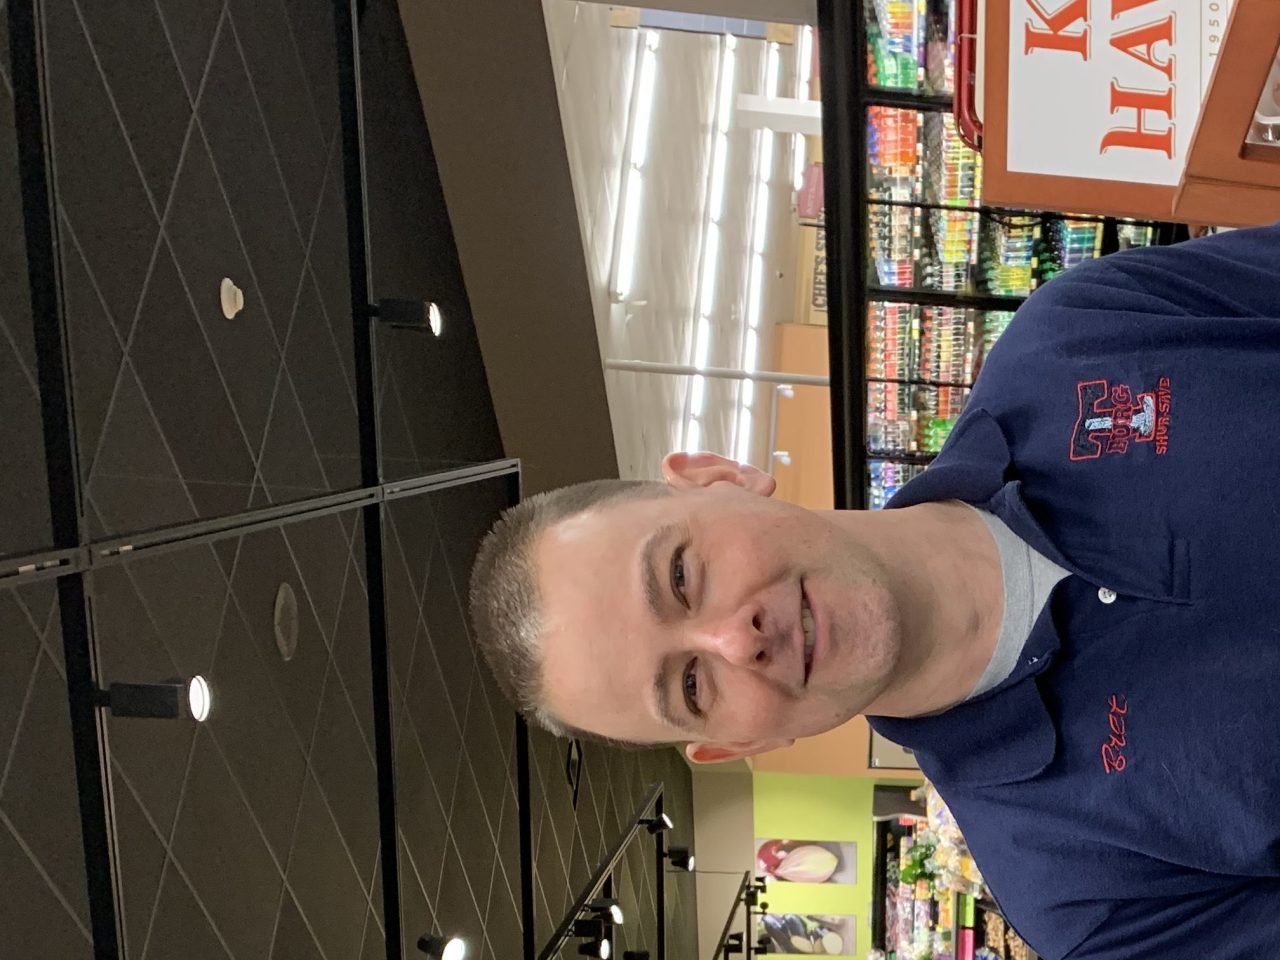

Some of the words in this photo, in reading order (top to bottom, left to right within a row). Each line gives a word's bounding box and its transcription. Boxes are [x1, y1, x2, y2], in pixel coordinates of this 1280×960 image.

[1105, 383, 1133, 454] BURG
[1155, 376, 1171, 454] SHUR-SAVE
[1101, 693, 1128, 774] Bret
